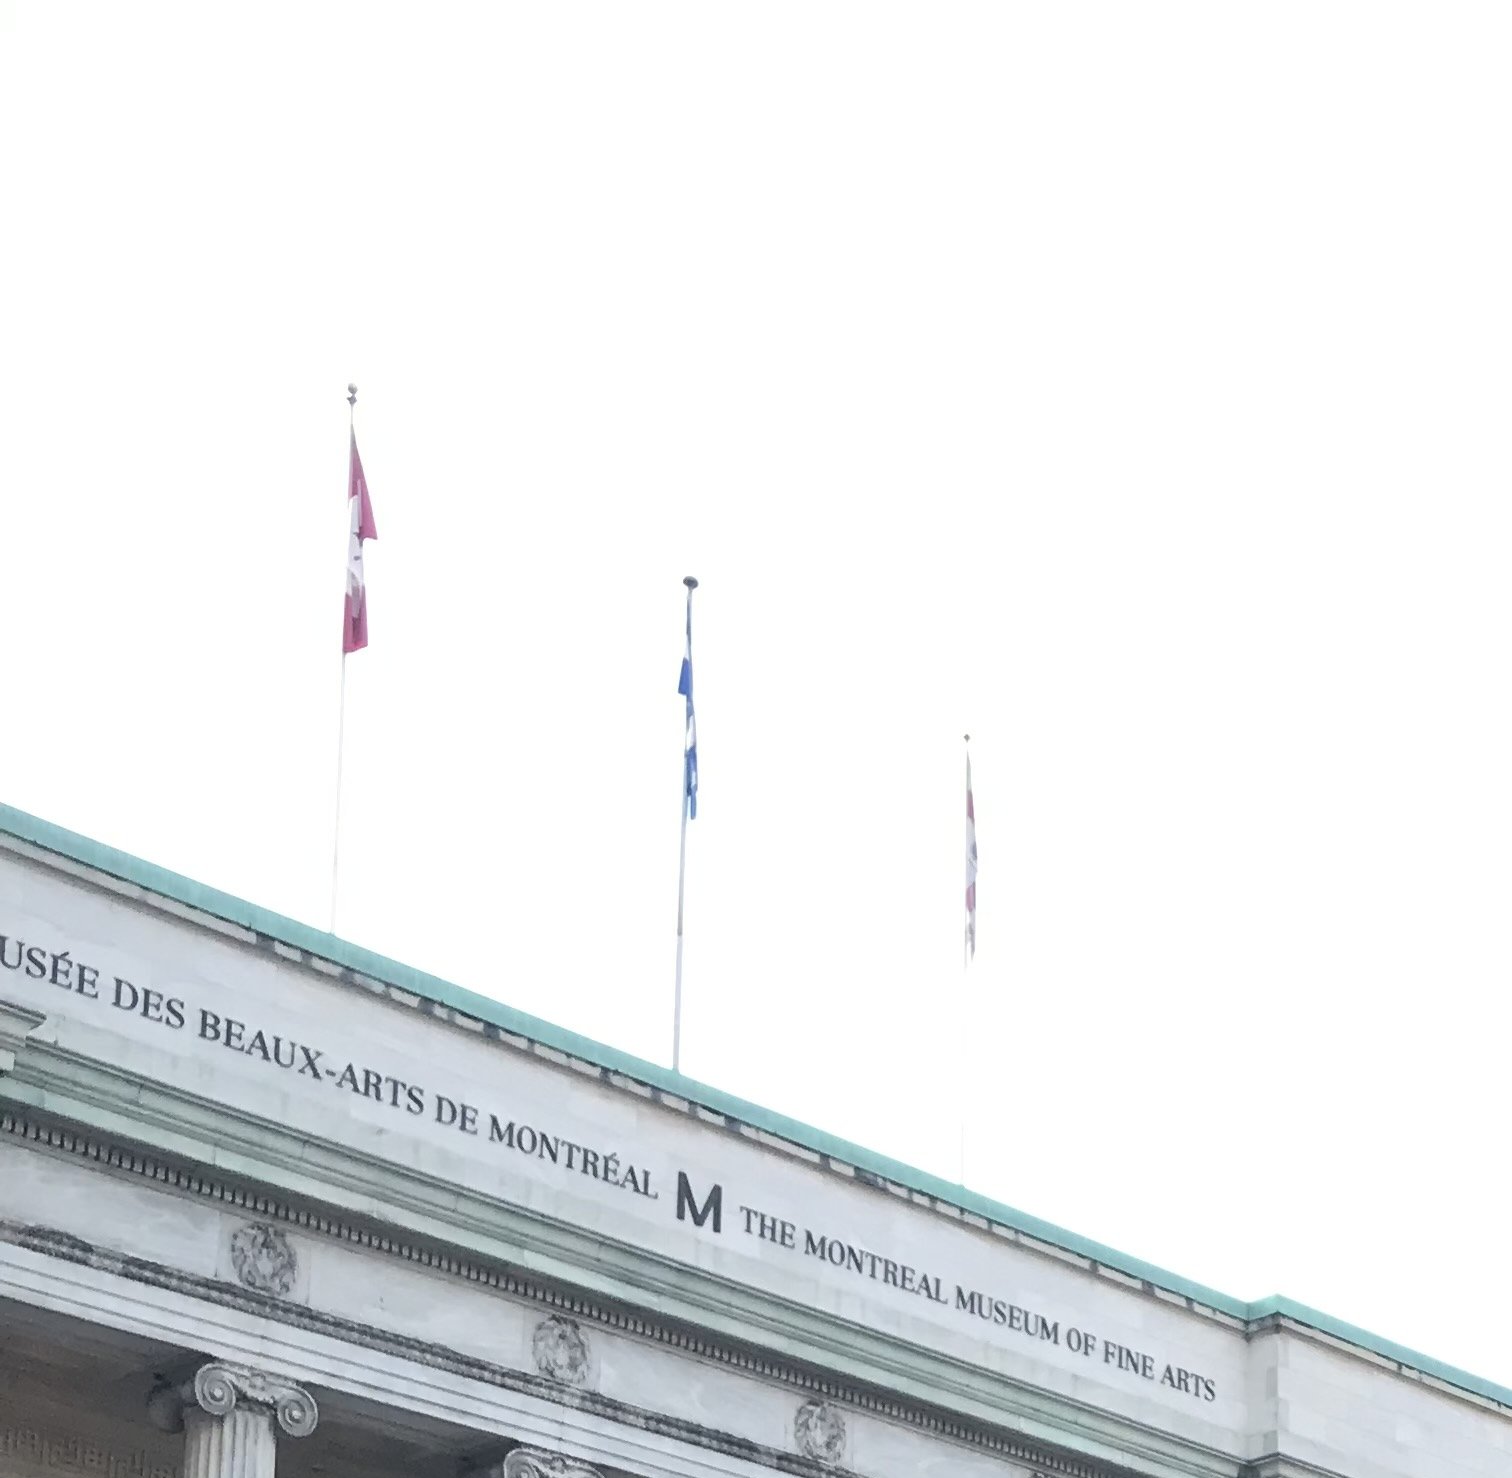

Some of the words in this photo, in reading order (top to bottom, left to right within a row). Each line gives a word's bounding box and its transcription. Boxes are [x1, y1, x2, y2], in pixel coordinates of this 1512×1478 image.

[112, 976, 185, 1029] DES
[199, 1008, 425, 1114] BEAUX-ARTS
[435, 1095, 476, 1135] DE
[488, 1119, 658, 1199] MONTRÉAL
[675, 1171, 722, 1233] M
[739, 1205, 796, 1249] THE
[803, 1229, 948, 1306] MONTREAL
[955, 1284, 1060, 1345] MUSEUM
[1065, 1327, 1098, 1357] OF
[1102, 1340, 1155, 1379] FINE
[1160, 1364, 1217, 1402] ARTS
